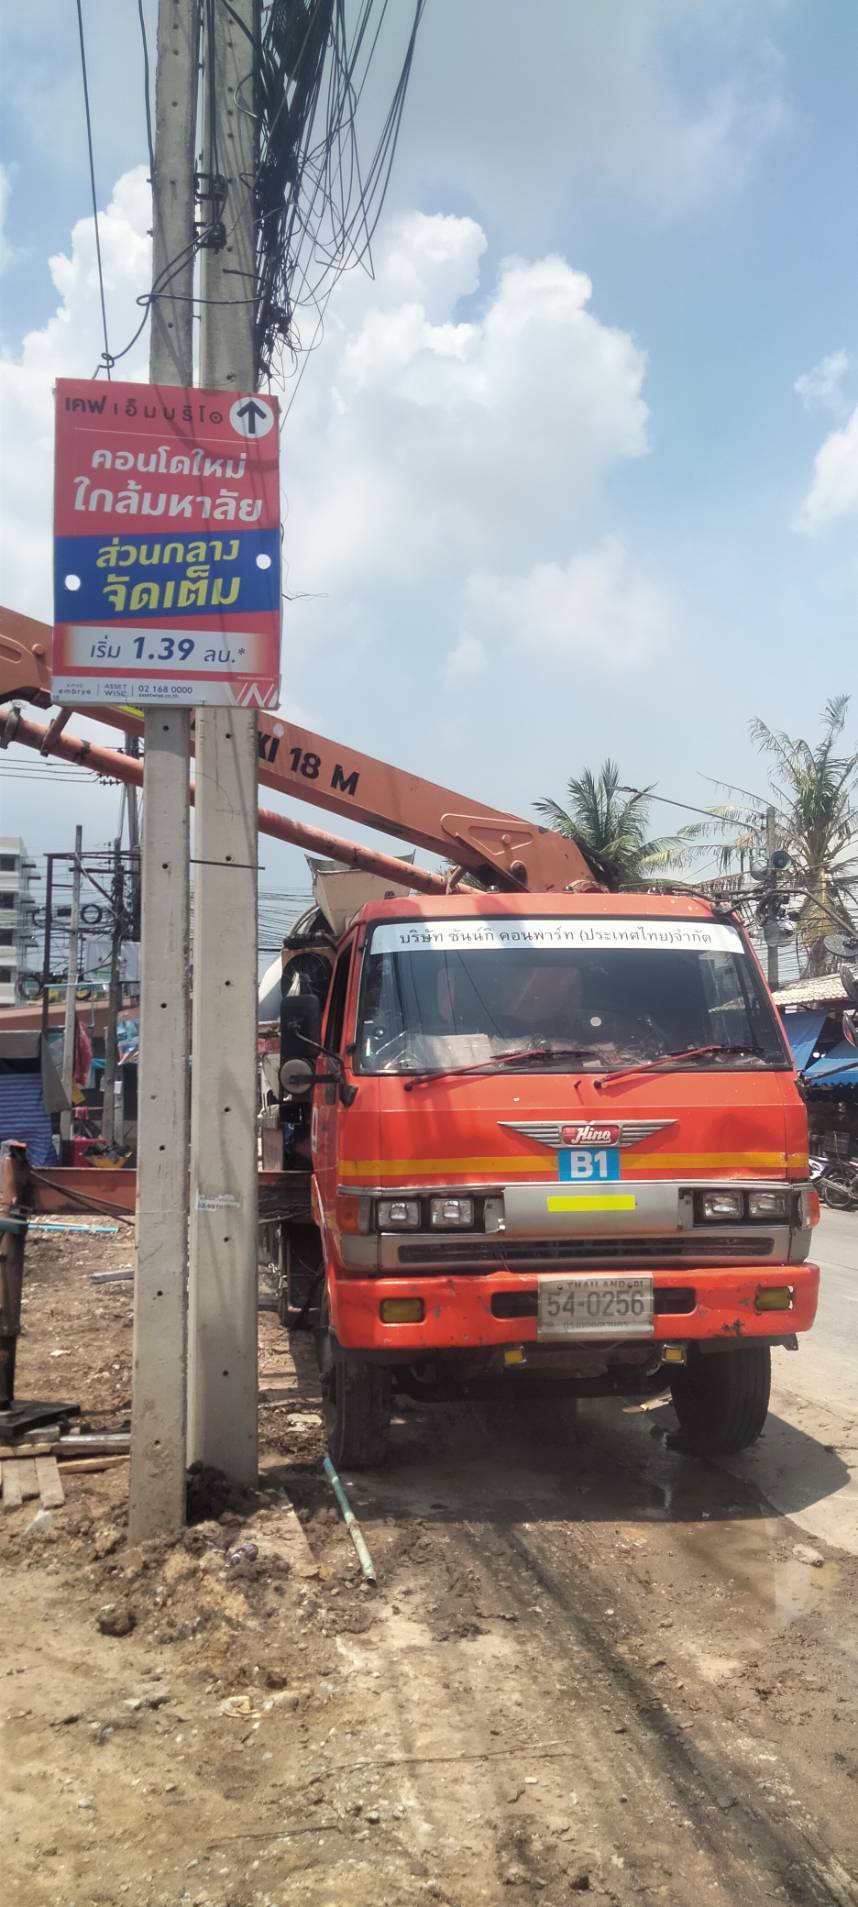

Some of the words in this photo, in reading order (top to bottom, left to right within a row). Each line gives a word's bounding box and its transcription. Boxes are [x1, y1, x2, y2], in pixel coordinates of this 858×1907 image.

[65, 394, 107, 414] เคฟ
[91, 445, 247, 479] คอนโดใหม่
[73, 476, 263, 522] ใกล้มหาลัย
[96, 536, 240, 568] ส่วนกลาง
[103, 565, 241, 612] จัดเต็ม
[90, 634, 121, 659] เริ่ม
[133, 636, 195, 661] 1.39
[138, 684, 149, 693] 02
[171, 686, 193, 695] 0000
[289, 747, 321, 779] 18
[330, 764, 360, 796] M
[399, 928, 444, 944] บริษัท
[499, 925, 575, 942] คอนพาร์ท
[571, 1124, 611, 1144] Hino
[570, 1150, 608, 1179] B1
[547, 1290, 644, 1317] 54-0256
